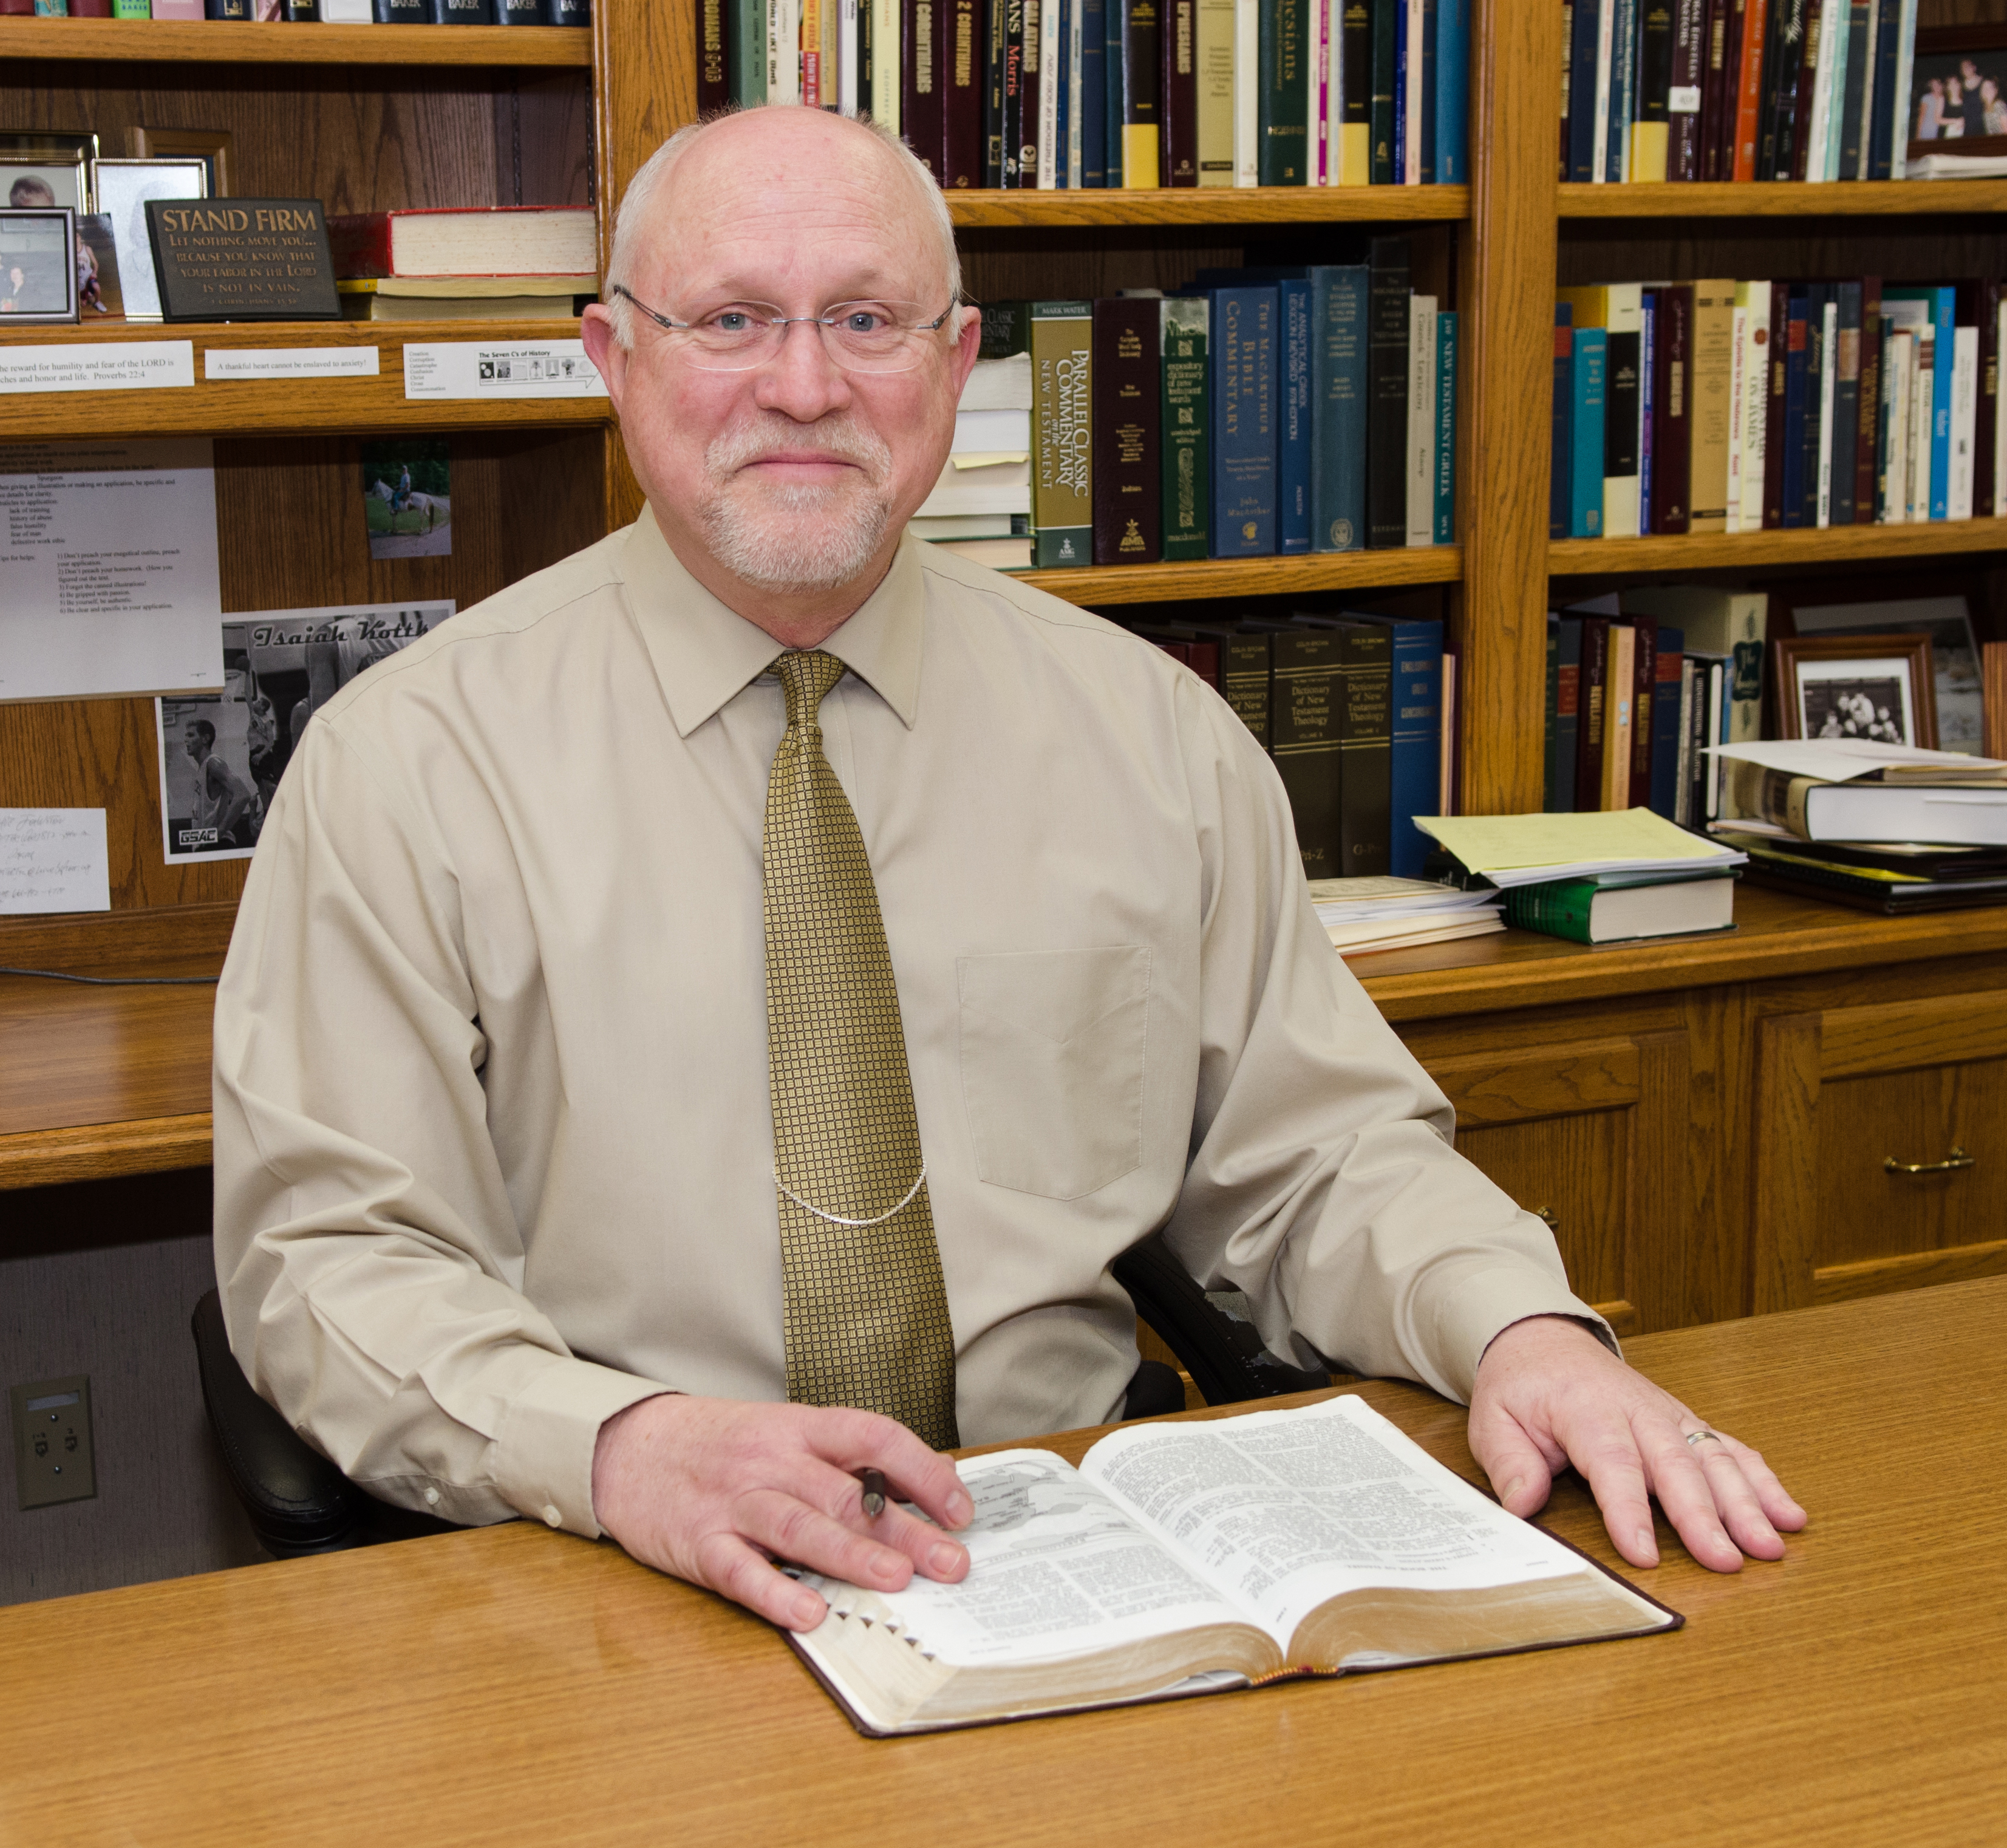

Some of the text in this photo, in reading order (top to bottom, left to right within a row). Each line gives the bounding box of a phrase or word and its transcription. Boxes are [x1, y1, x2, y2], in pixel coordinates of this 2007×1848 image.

[1023, 1, 1038, 73] GALATIANS
[916, 3, 932, 94] CORINTHIANS
[955, 13, 972, 87] CORINTHIANS
[1007, 45, 1020, 97] Morris
[163, 210, 317, 232] STAND FIRM
[193, 237, 244, 245] NOTHING
[248, 237, 277, 245] MOVE
[176, 252, 315, 262] BECAUSE YOU KNOW THAT
[181, 268, 210, 278] YOUR
[214, 268, 247, 277] LABOR
[250, 268, 262, 277] IN
[266, 268, 284, 277] THE
[203, 283, 300, 293] IS NOT IN VAIN.
[1737, 317, 1745, 333] The
[341, 359, 366, 367] anxiety!
[1227, 301, 1240, 436] COMMENTARY
[1242, 341, 1255, 395] BIBLE
[75, 372, 89, 381] life.
[1041, 360, 1052, 489] NEW TESTAMENT
[1055, 359, 1074, 488] COMMENTARY
[1071, 350, 1090, 497] PARALLEL CLASSIC
[1440, 341, 1454, 497] NEW TESTAMENT GREEK
[1051, 419, 1061, 446] on the
[254, 625, 348, 647] Isaiah
[1292, 685, 1330, 696] Dictionary
[1348, 683, 1388, 692] Dictionary
[180, 830, 216, 843] GSAC
